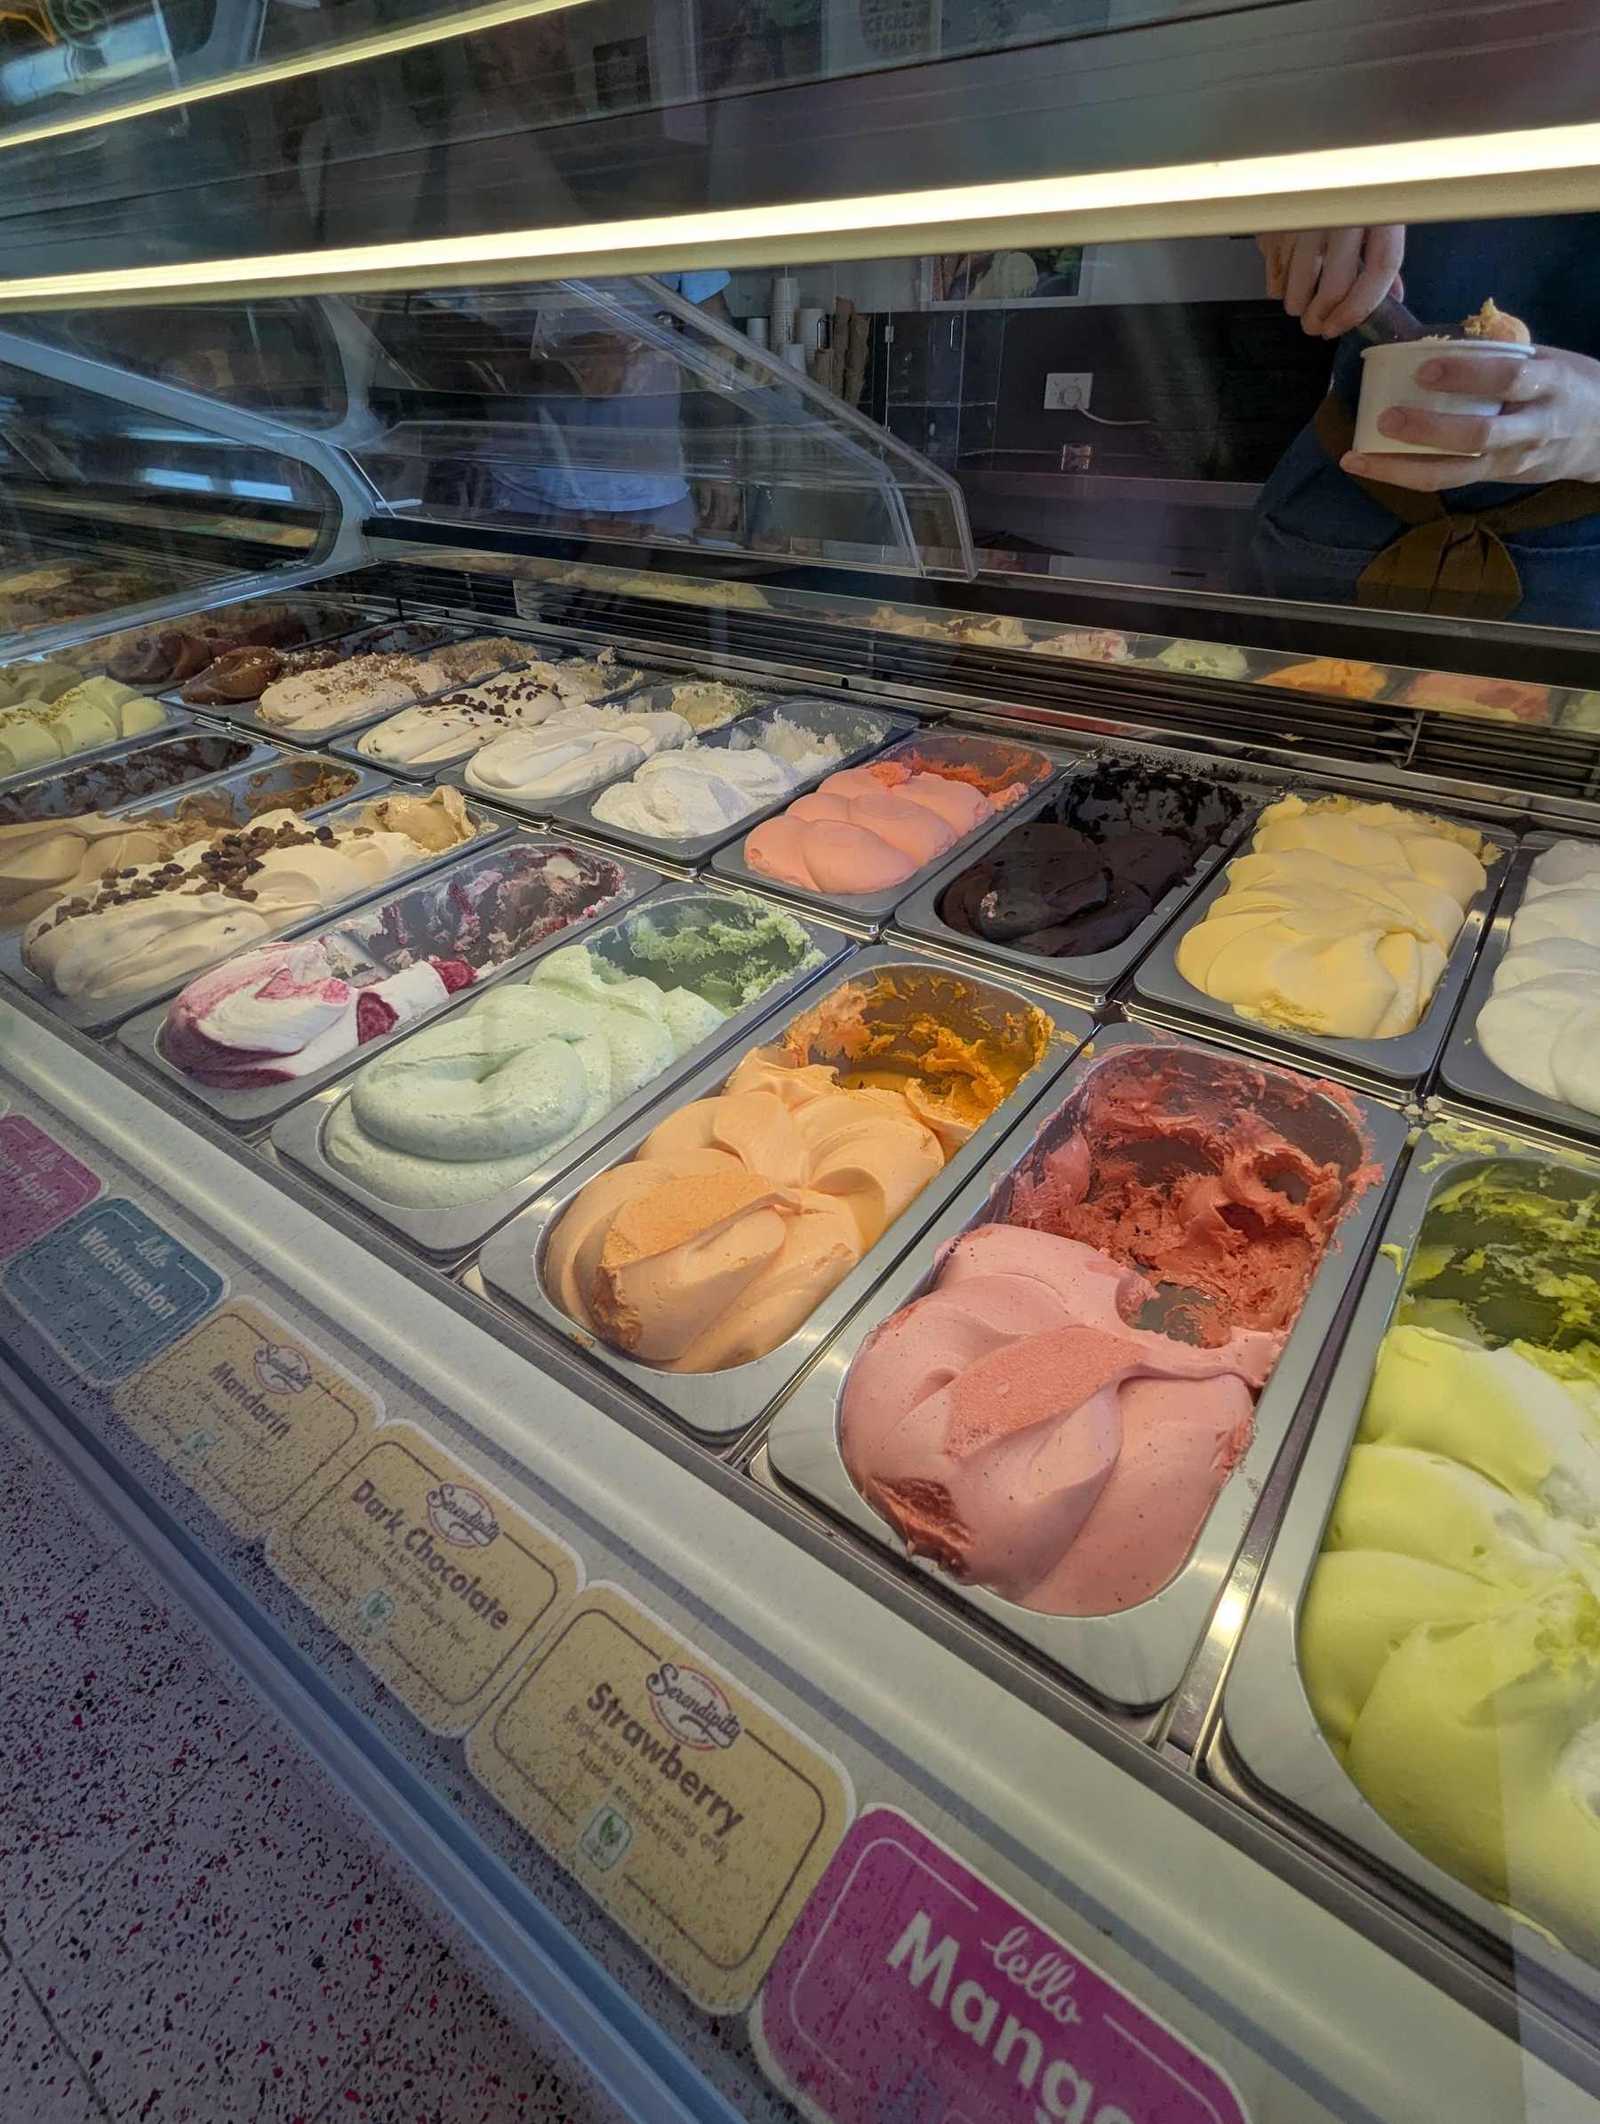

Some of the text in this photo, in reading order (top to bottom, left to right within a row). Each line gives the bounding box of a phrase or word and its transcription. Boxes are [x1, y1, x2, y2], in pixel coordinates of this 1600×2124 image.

[78, 1226, 177, 1321] Watermelon
[208, 1361, 292, 1440] Mandarin
[352, 1479, 405, 1535] Dark
[404, 1528, 509, 1631] Chocolate
[645, 1662, 742, 1749] Serendipity
[587, 1682, 745, 1837] Strawberry
[980, 1925, 1082, 2025] lello
